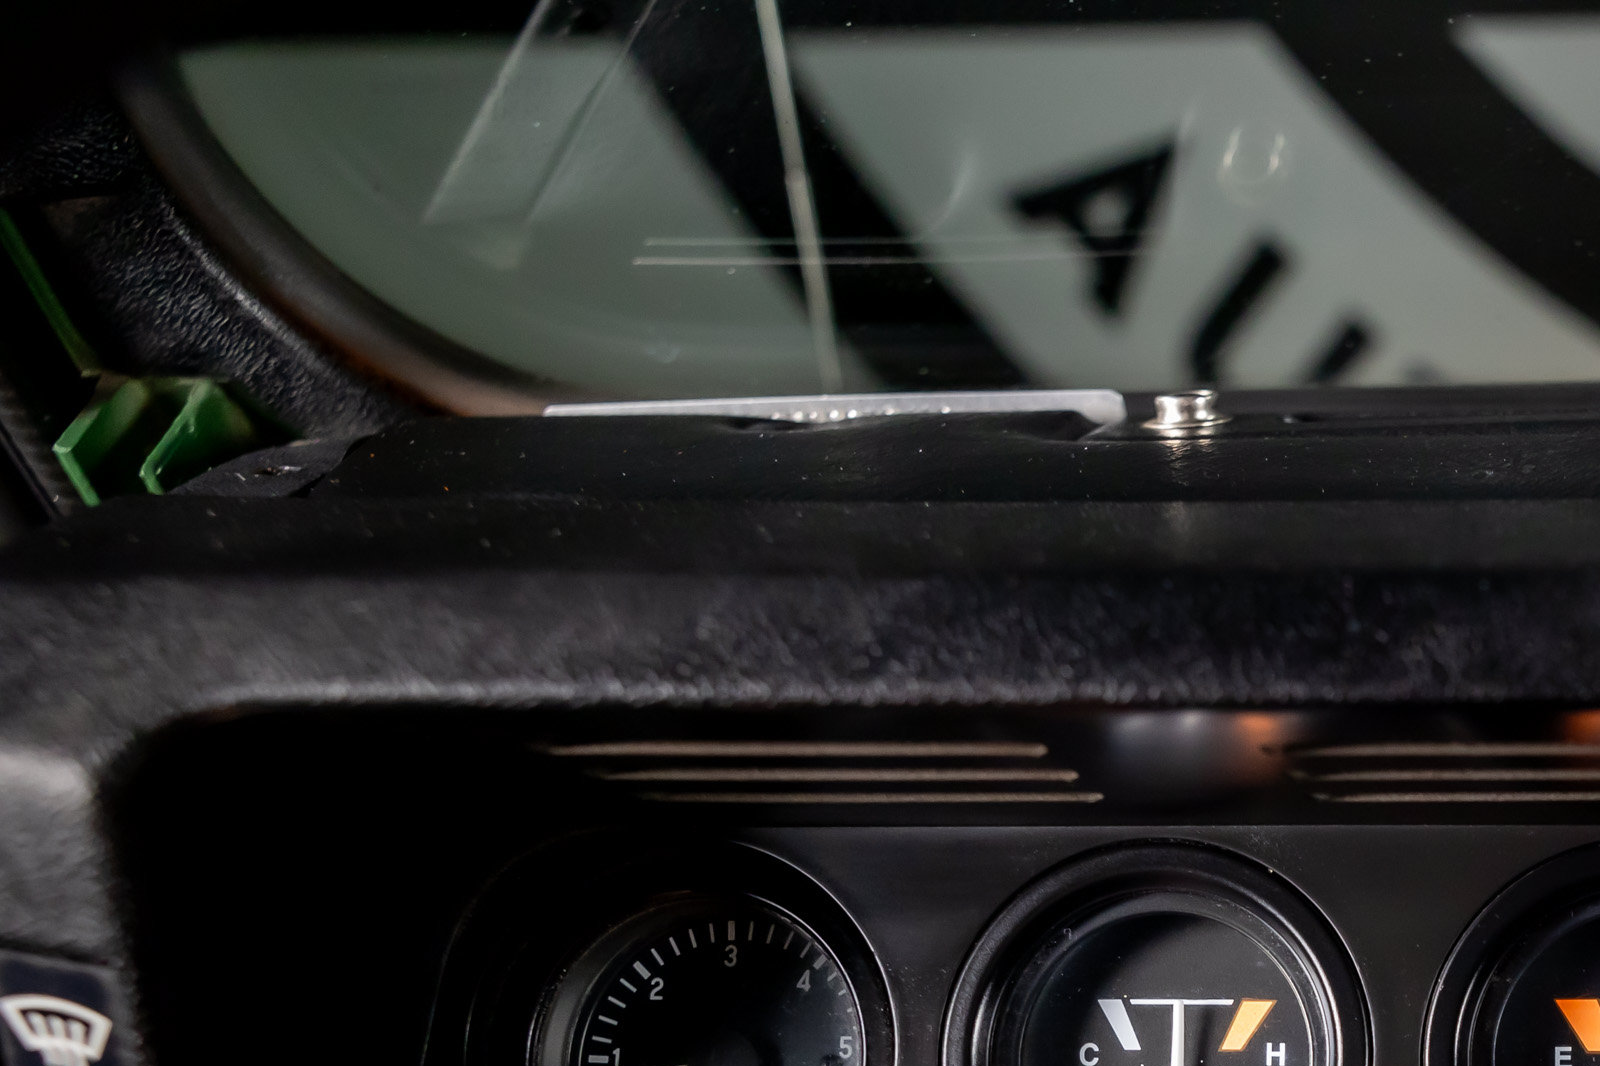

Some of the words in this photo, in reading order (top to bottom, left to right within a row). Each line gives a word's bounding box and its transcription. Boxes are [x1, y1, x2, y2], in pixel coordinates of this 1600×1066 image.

[723, 945, 738, 967] 3
[649, 979, 663, 1000] 2
[796, 969, 811, 991] 4
[838, 1036, 852, 1059] 5
[1079, 1043, 1099, 1066] C
[1267, 1043, 1285, 1066] H
